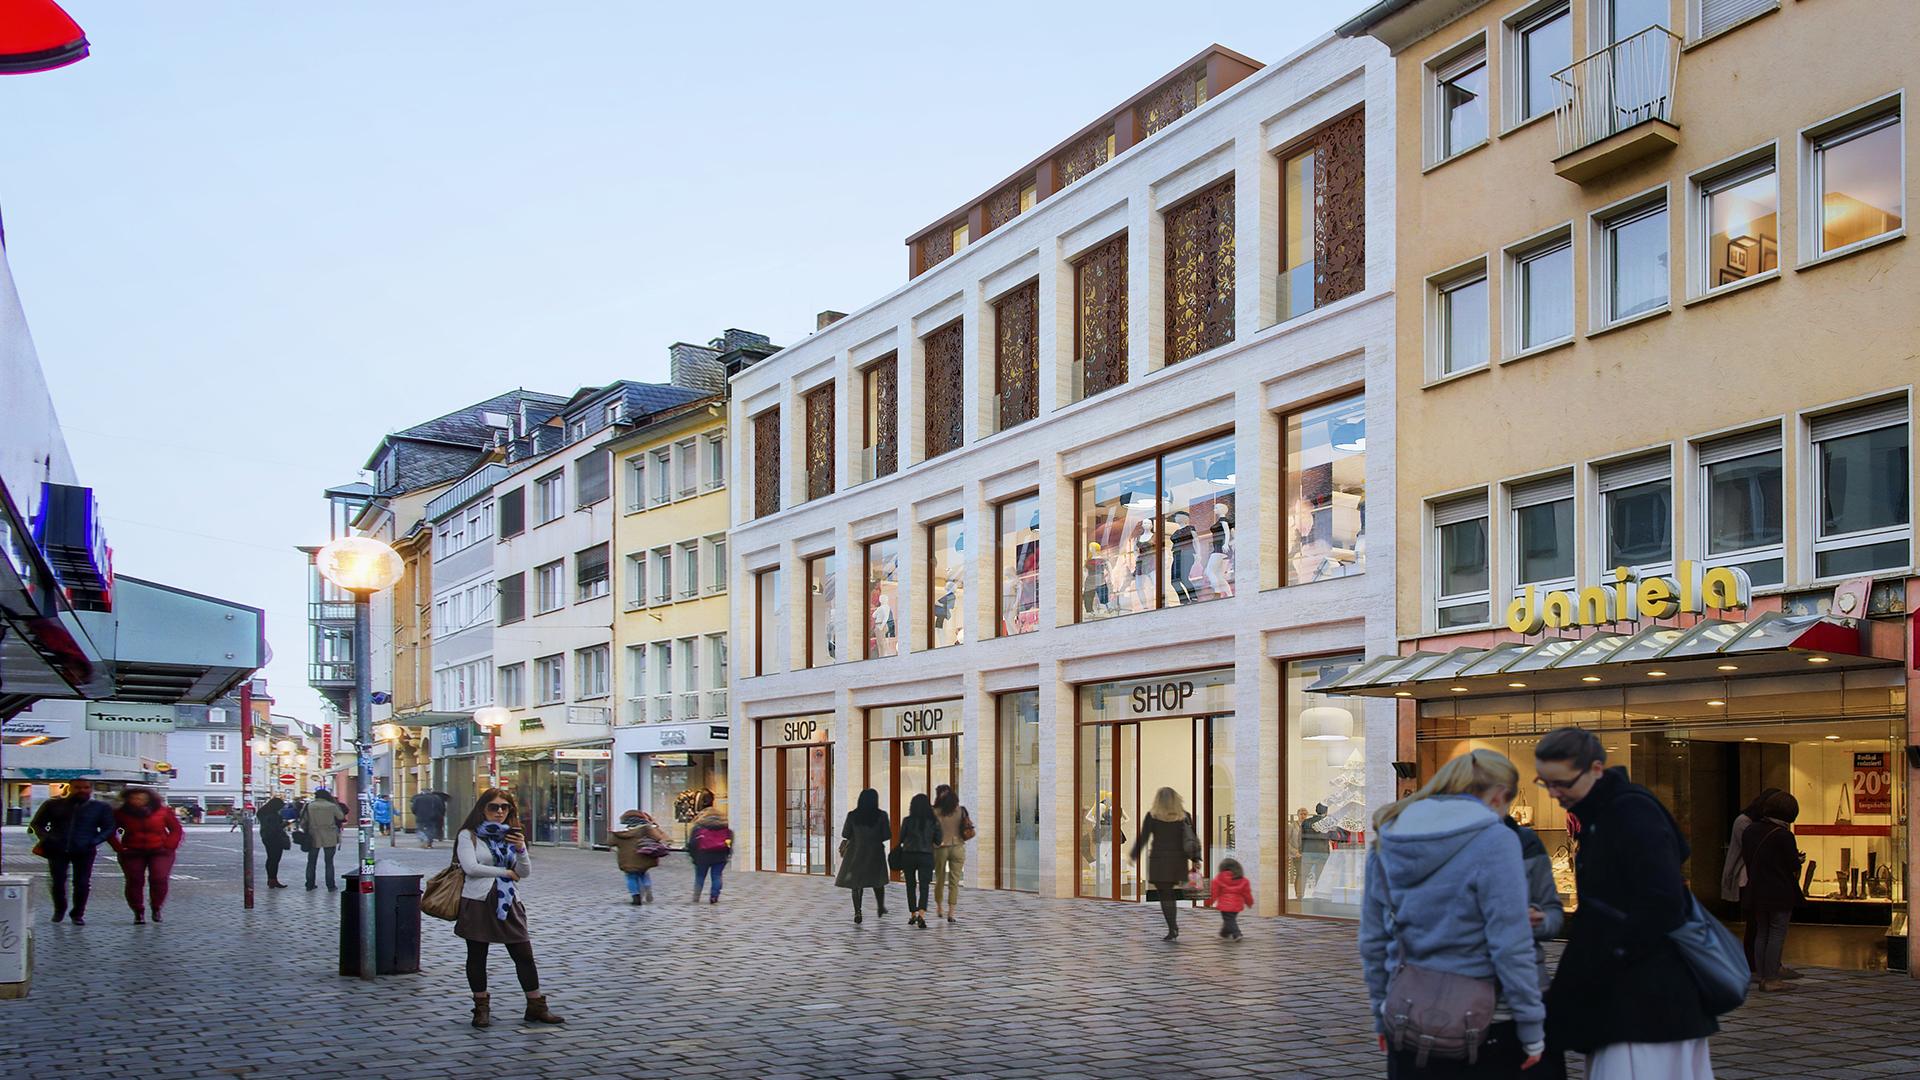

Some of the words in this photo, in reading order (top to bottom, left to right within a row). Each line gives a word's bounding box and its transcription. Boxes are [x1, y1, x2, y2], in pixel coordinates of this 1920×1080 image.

[1507, 560, 1750, 635] daniela
[1132, 681, 1194, 714] SHOP
[89, 712, 173, 724] tamaris
[784, 720, 817, 742] SHOP
[903, 708, 944, 733] SHOP
[323, 723, 332, 769] WOOLWORTH
